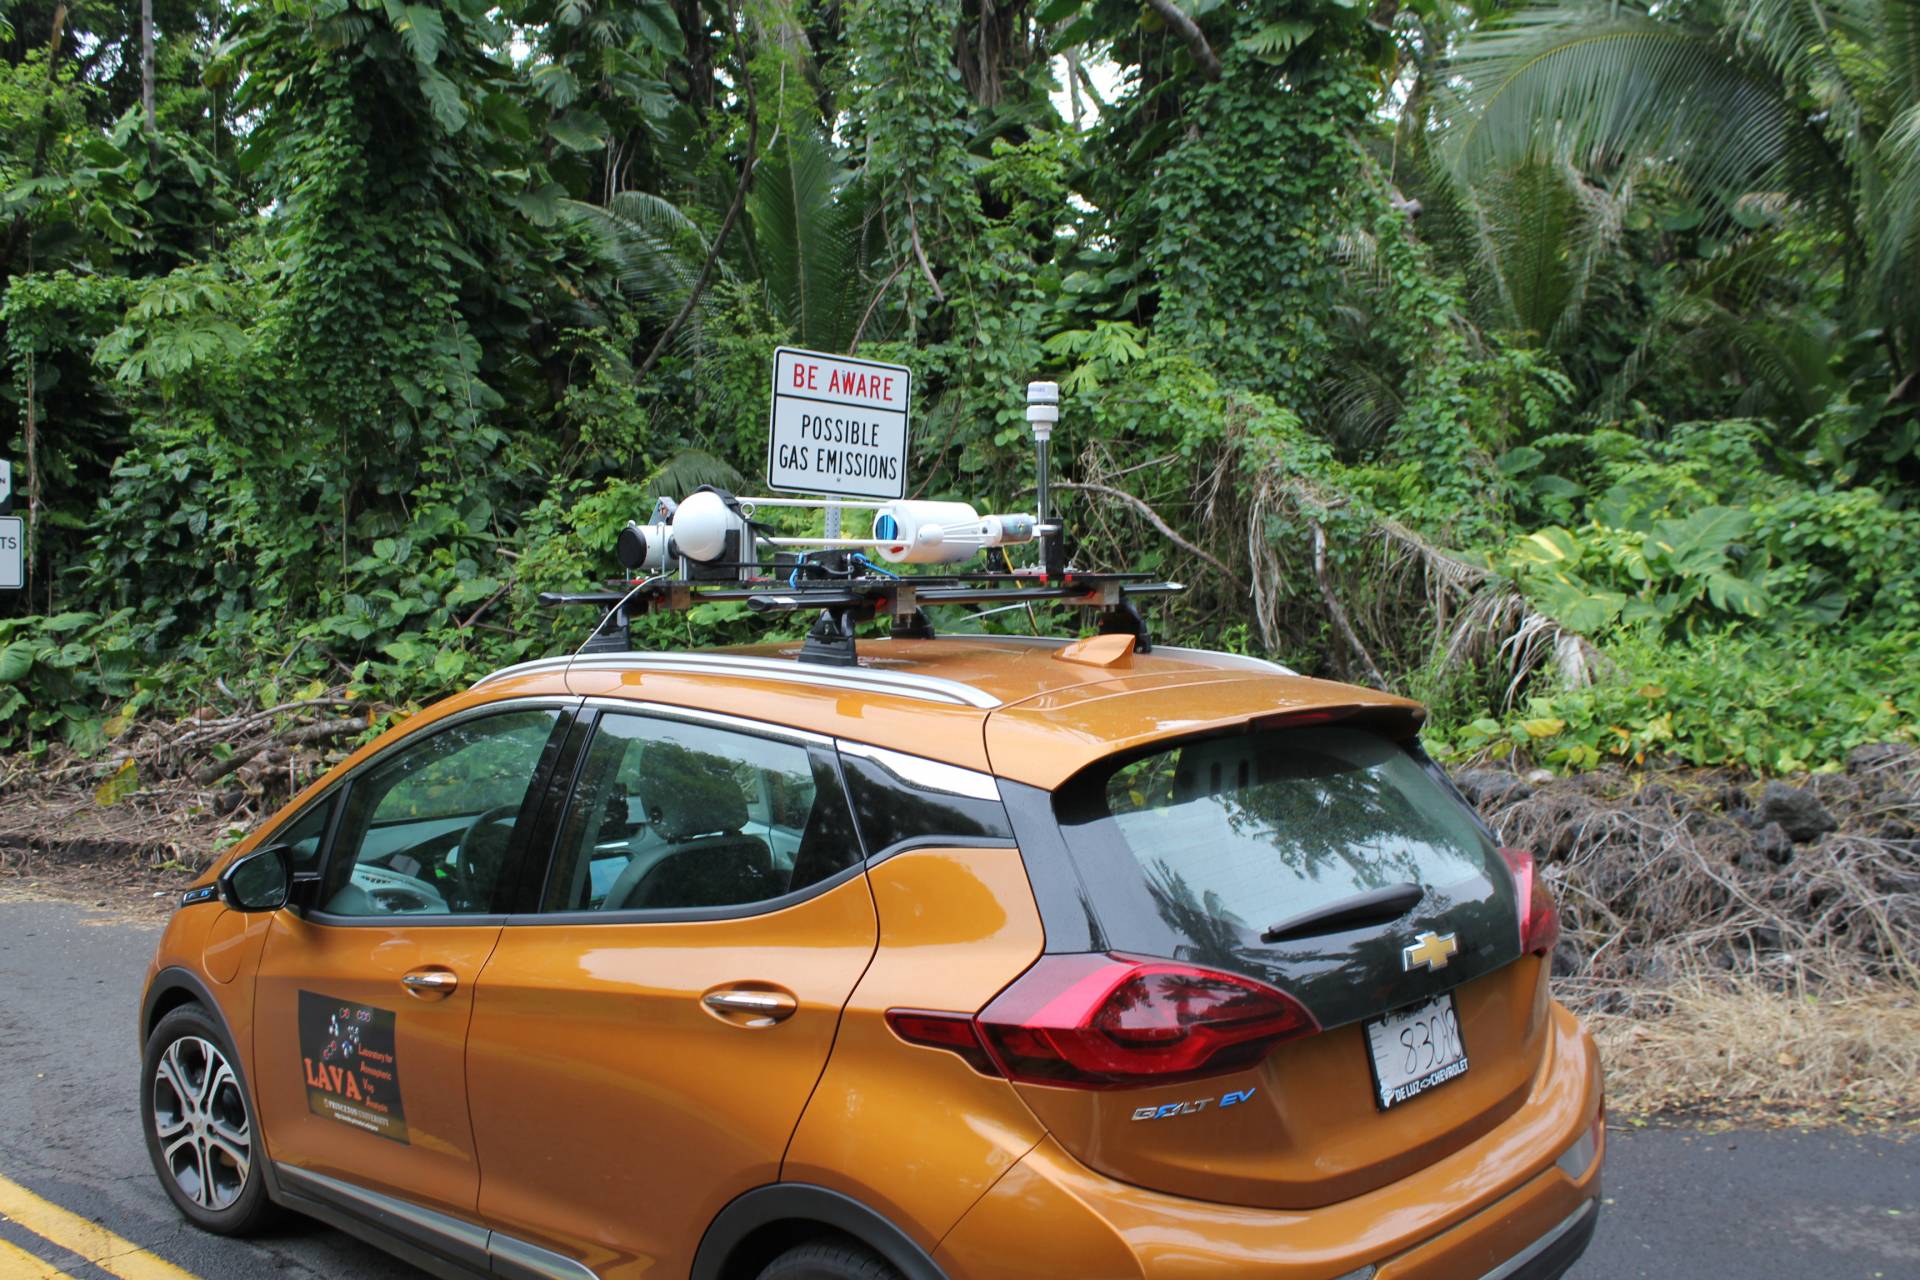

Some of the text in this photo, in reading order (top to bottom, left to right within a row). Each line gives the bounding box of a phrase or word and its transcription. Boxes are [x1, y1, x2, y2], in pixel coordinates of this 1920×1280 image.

[793, 363, 894, 401] BE AWARE
[801, 414, 879, 448] POSSIBLE
[779, 444, 897, 480] GAS EMISSIONS
[304, 1058, 362, 1101] LAVA
[1219, 1087, 1256, 1108] EV
[1395, 1058, 1468, 1102] DE LUZ CHEVROLET
